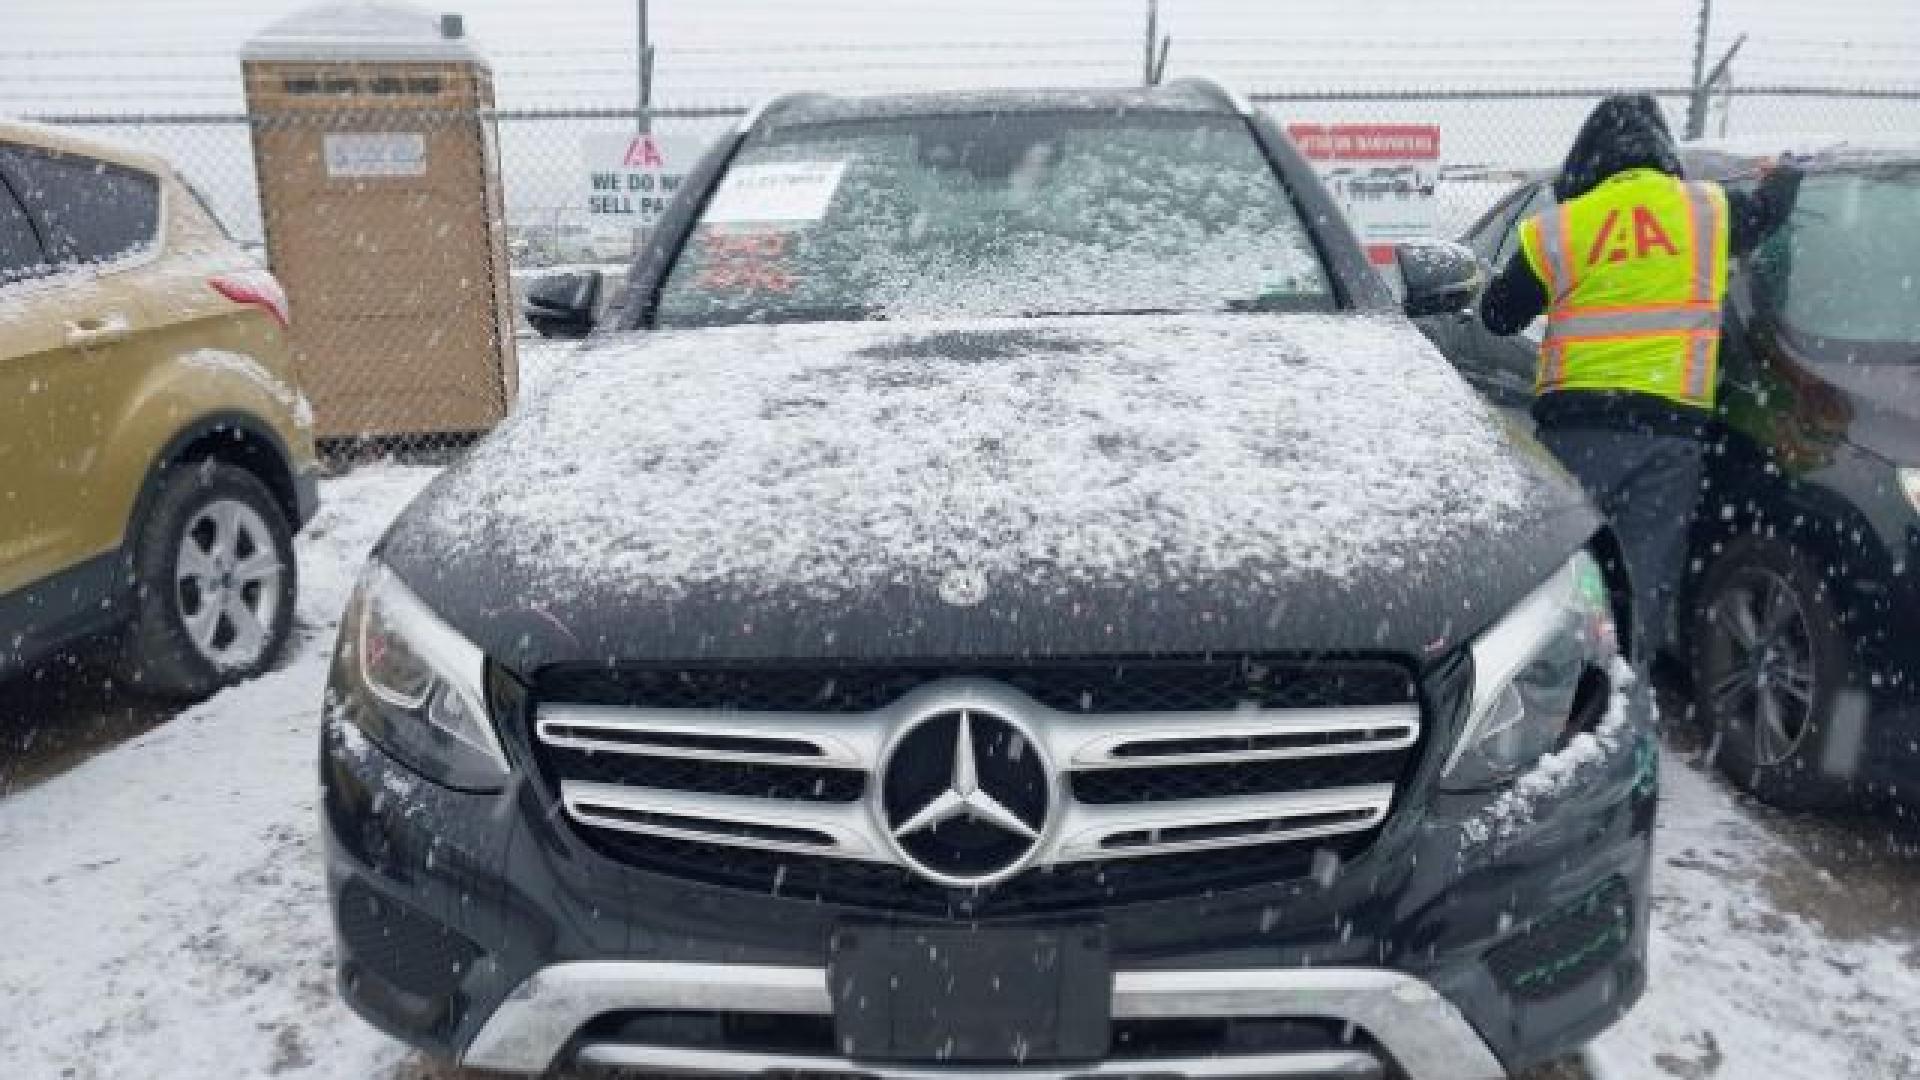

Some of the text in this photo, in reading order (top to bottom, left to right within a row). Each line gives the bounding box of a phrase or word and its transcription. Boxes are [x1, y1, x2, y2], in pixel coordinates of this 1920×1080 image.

[591, 173, 621, 191] WE
[628, 173, 655, 191] DO
[589, 196, 633, 214] SELL
